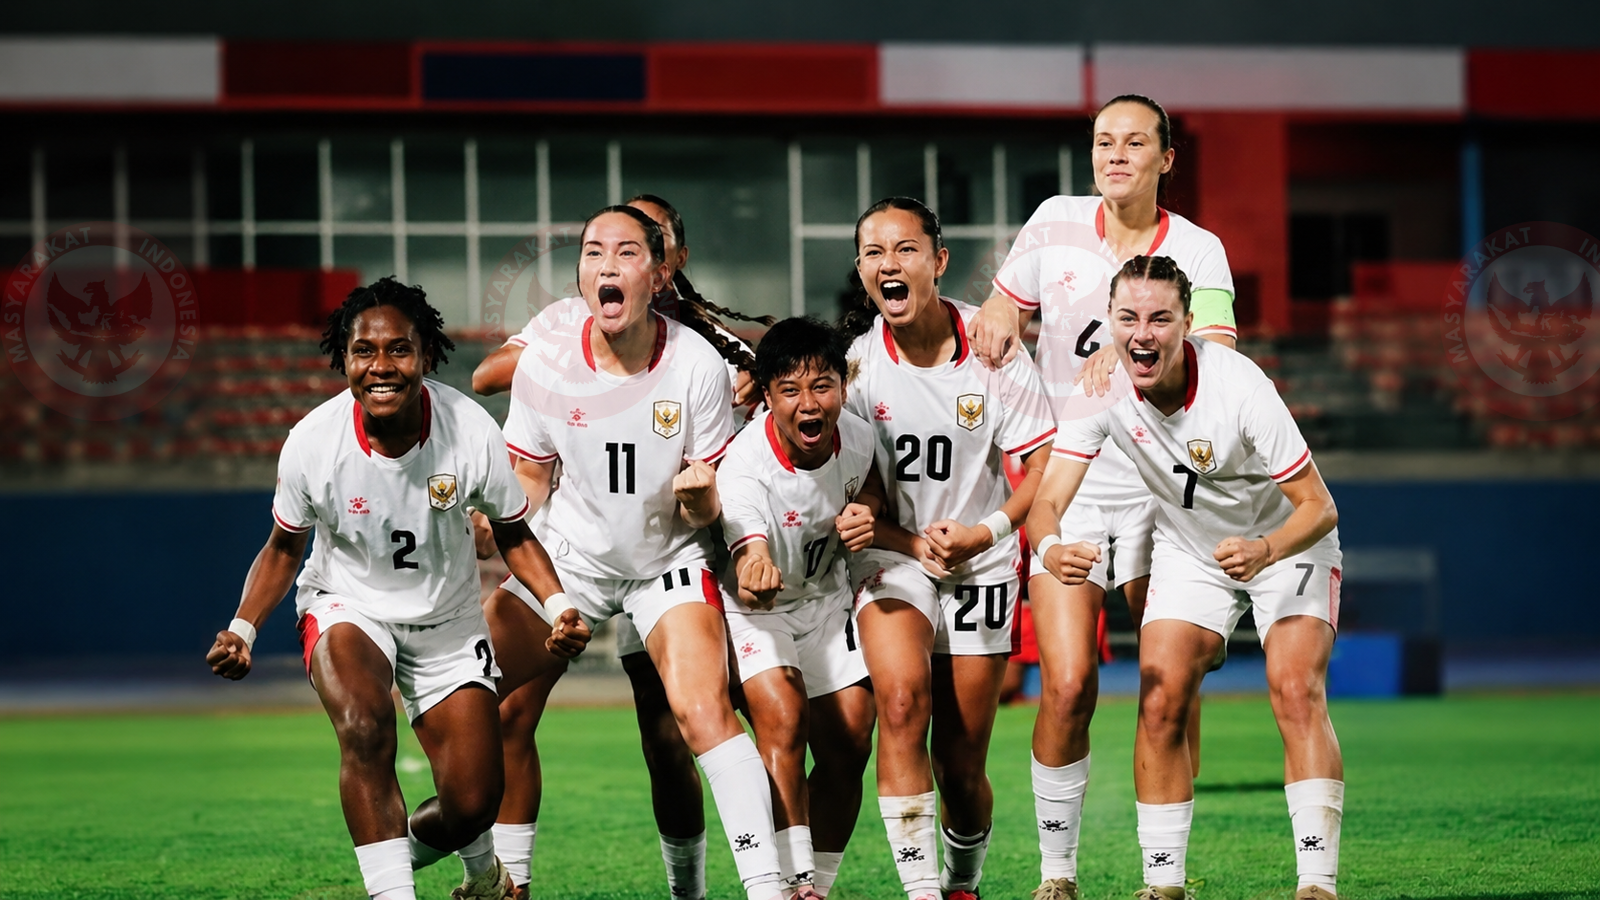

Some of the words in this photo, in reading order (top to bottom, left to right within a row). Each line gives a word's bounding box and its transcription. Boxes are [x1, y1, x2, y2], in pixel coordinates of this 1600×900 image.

[1074, 319, 1103, 358] 6
[605, 442, 636, 494] 11
[895, 433, 952, 482] 20
[1172, 464, 1198, 509] 7
[390, 529, 419, 569] 2
[1294, 562, 1315, 597] 7
[954, 582, 1008, 632] 20
